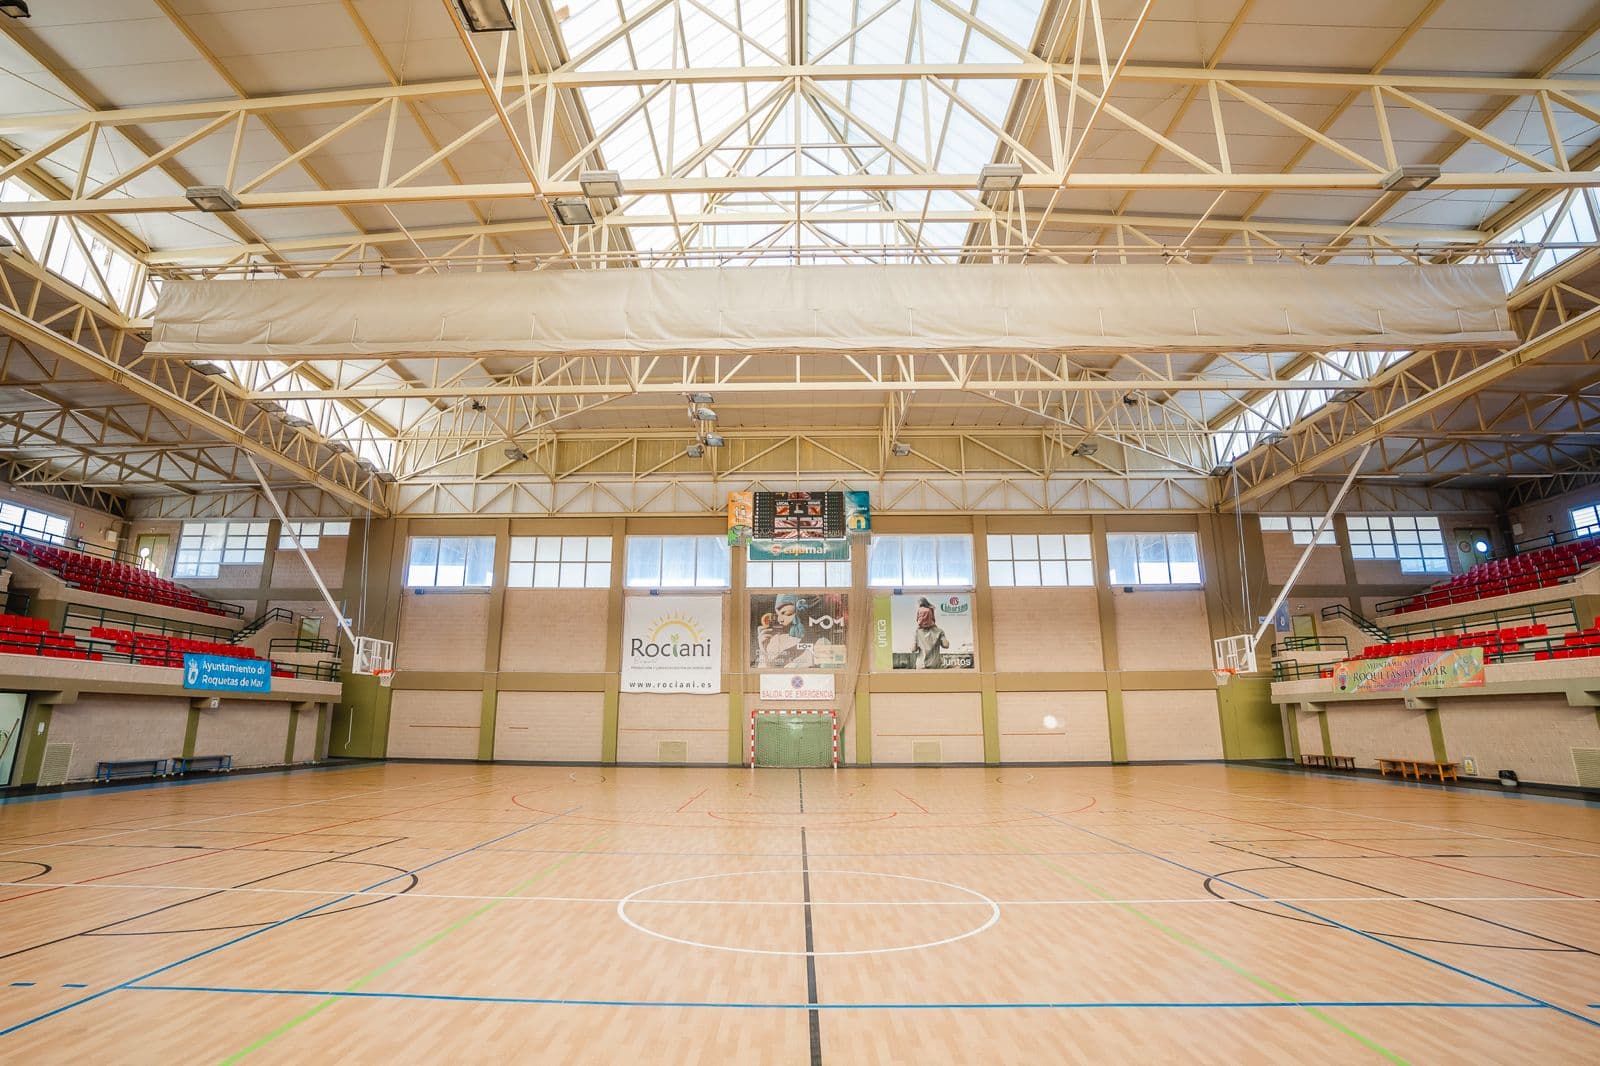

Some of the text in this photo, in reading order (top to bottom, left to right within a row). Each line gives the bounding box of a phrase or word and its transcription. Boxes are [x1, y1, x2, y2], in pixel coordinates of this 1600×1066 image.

[783, 543, 827, 556] cajamar
[808, 614, 845, 630] MOM
[631, 638, 712, 657] Rociani
[202, 661, 256, 674] Ayuntamiento
[1352, 671, 1402, 682] ROQUETAS
[1421, 665, 1448, 676] MAR
[202, 675, 264, 688] Roquetas de Mar
[629, 680, 713, 689] www.rociani.es
[761, 690, 834, 699] SALIDA DE EMERGENCIA
